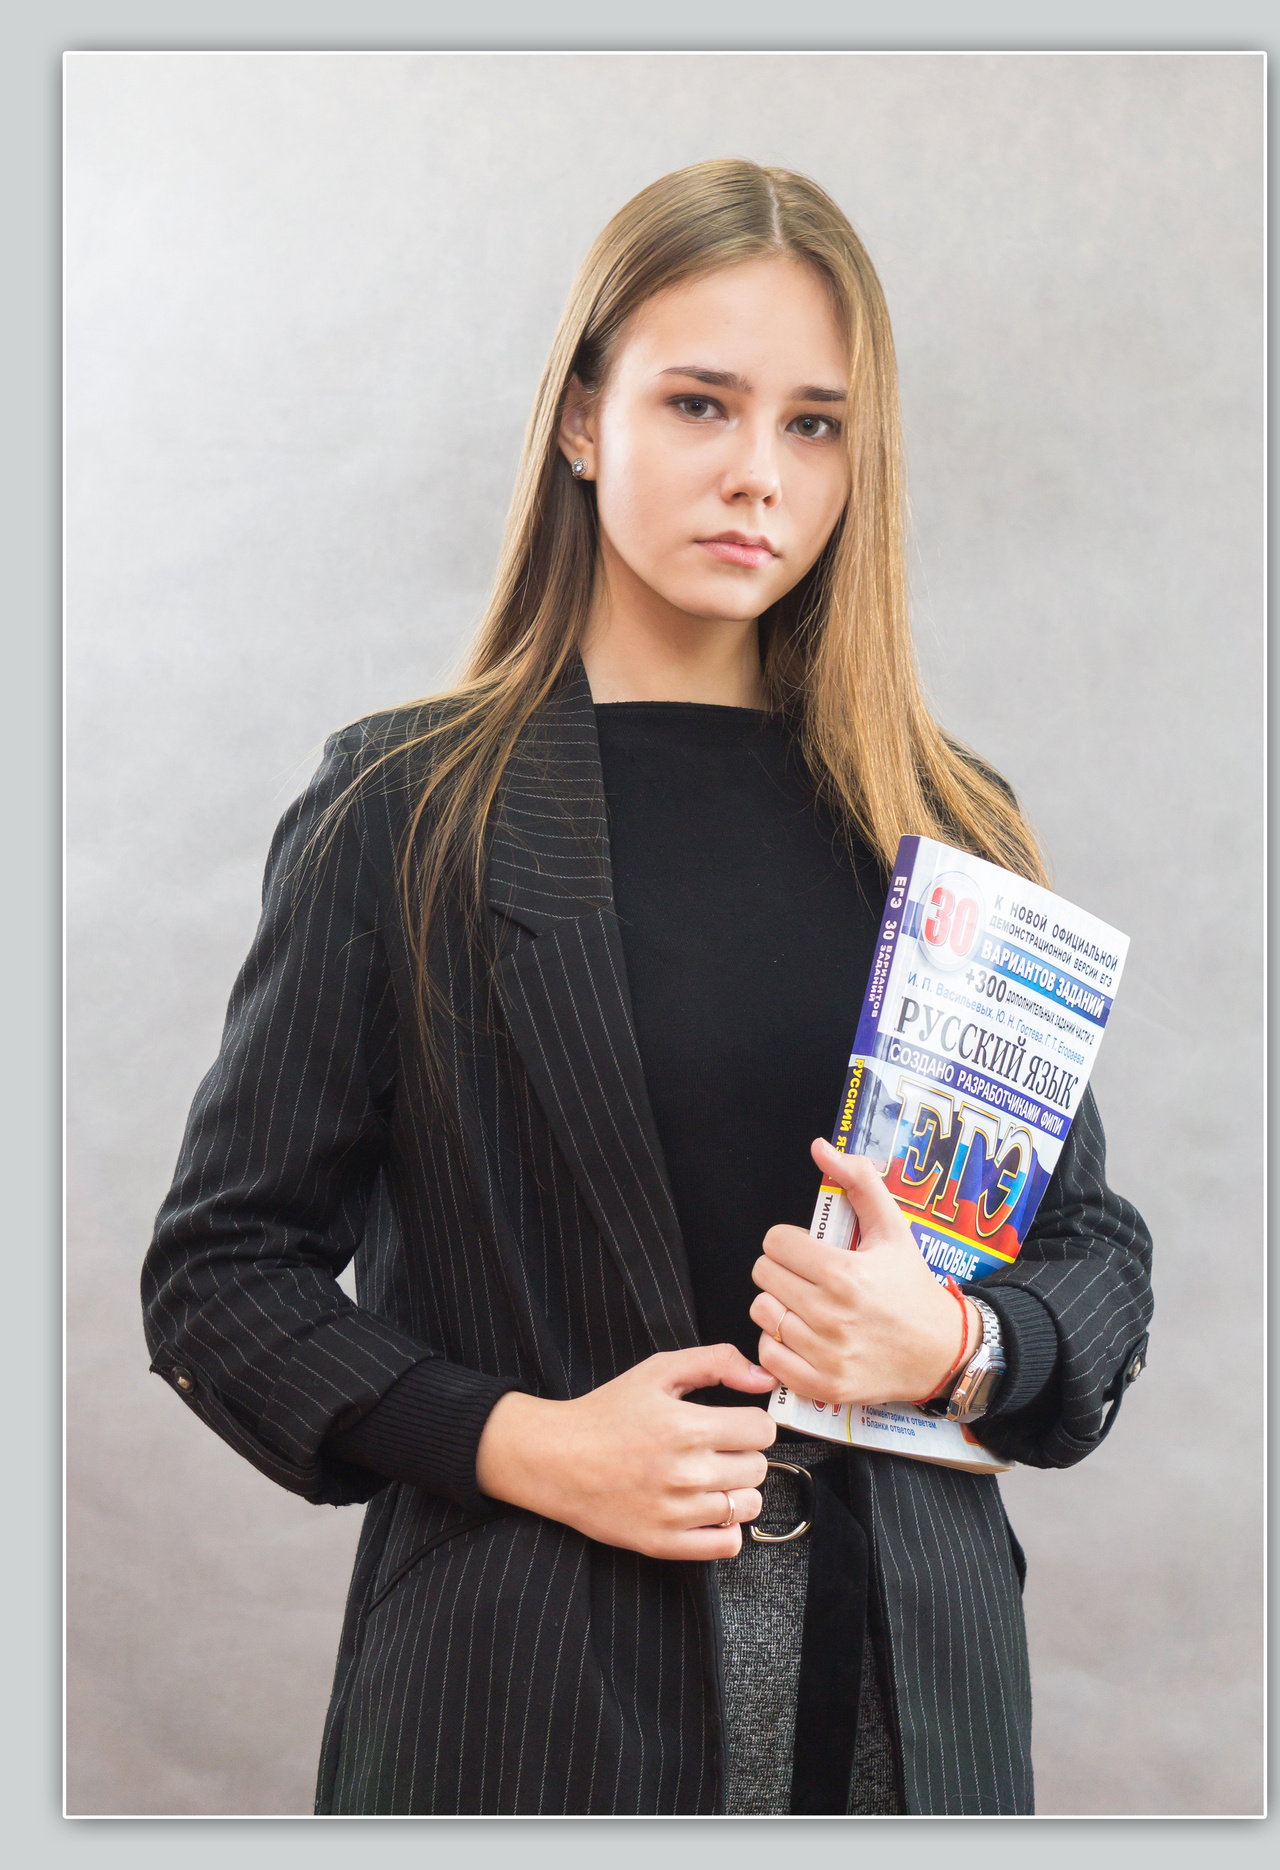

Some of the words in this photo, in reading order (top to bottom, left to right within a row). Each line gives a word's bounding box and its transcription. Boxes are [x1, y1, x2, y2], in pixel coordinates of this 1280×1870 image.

[890, 876, 907, 908] ЕГЭ
[924, 887, 979, 955] 30
[883, 920, 897, 940] 30
[989, 915, 1072, 965] ДЕМОНСТРАЦИОННОЙ
[1073, 958, 1099, 980] ВЕРСИИ
[1099, 972, 1113, 988] ЕГЭ
[994, 894, 1003, 910] К
[1010, 901, 1048, 932] НОВОЙ
[1052, 924, 1118, 971] ОФИЦИАЛЬНОЙ
[868, 944, 886, 1002] ЗАДАНИЙ
[871, 944, 893, 1018] ВАРИАНТОВ
[966, 968, 1007, 1002] +300
[1005, 990, 1055, 1024] ДОПОЛНИТЕЛЬНЫХ
[1054, 1014, 1077, 1035] ЗАДАНИЙ
[1075, 1026, 1091, 1043] ЧАСТИ
[1089, 1034, 1095, 1045] 2
[981, 939, 1056, 991] ВАРИАНТОВ
[1056, 977, 1105, 1018] ЗАДАНИЙ
[893, 996, 1026, 1083] РУССКИЙ
[1022, 1055, 1079, 1110] ЯЗЫК
[907, 971, 918, 987] И.
[921, 977, 932, 992] П.
[936, 982, 994, 1019] Васильевых,
[995, 1008, 1006, 1024] Ю.
[1006, 1014, 1015, 1029] Н.
[1016, 1019, 1044, 1043] Гостева,
[1045, 1033, 1051, 1047] Г.
[1052, 1037, 1058, 1051] Т.
[1057, 1041, 1085, 1065] Егораева
[840, 1058, 865, 1132] РУССКИЙ
[890, 1043, 955, 1083] СОЗДАНО
[956, 1070, 1041, 1123] РАЗРАБОТЧИКАМИ
[1040, 1111, 1064, 1136] ФИПИ
[877, 1075, 1033, 1237] ЕГЭ
[816, 1194, 833, 1240] ТИПОВ
[919, 1232, 980, 1281] ТИПОВЫЕ
[866, 1405, 906, 1423] Комментарии
[910, 1417, 937, 1429] ответам
[866, 1417, 889, 1431] Бланки
[889, 1425, 916, 1436] ответов
